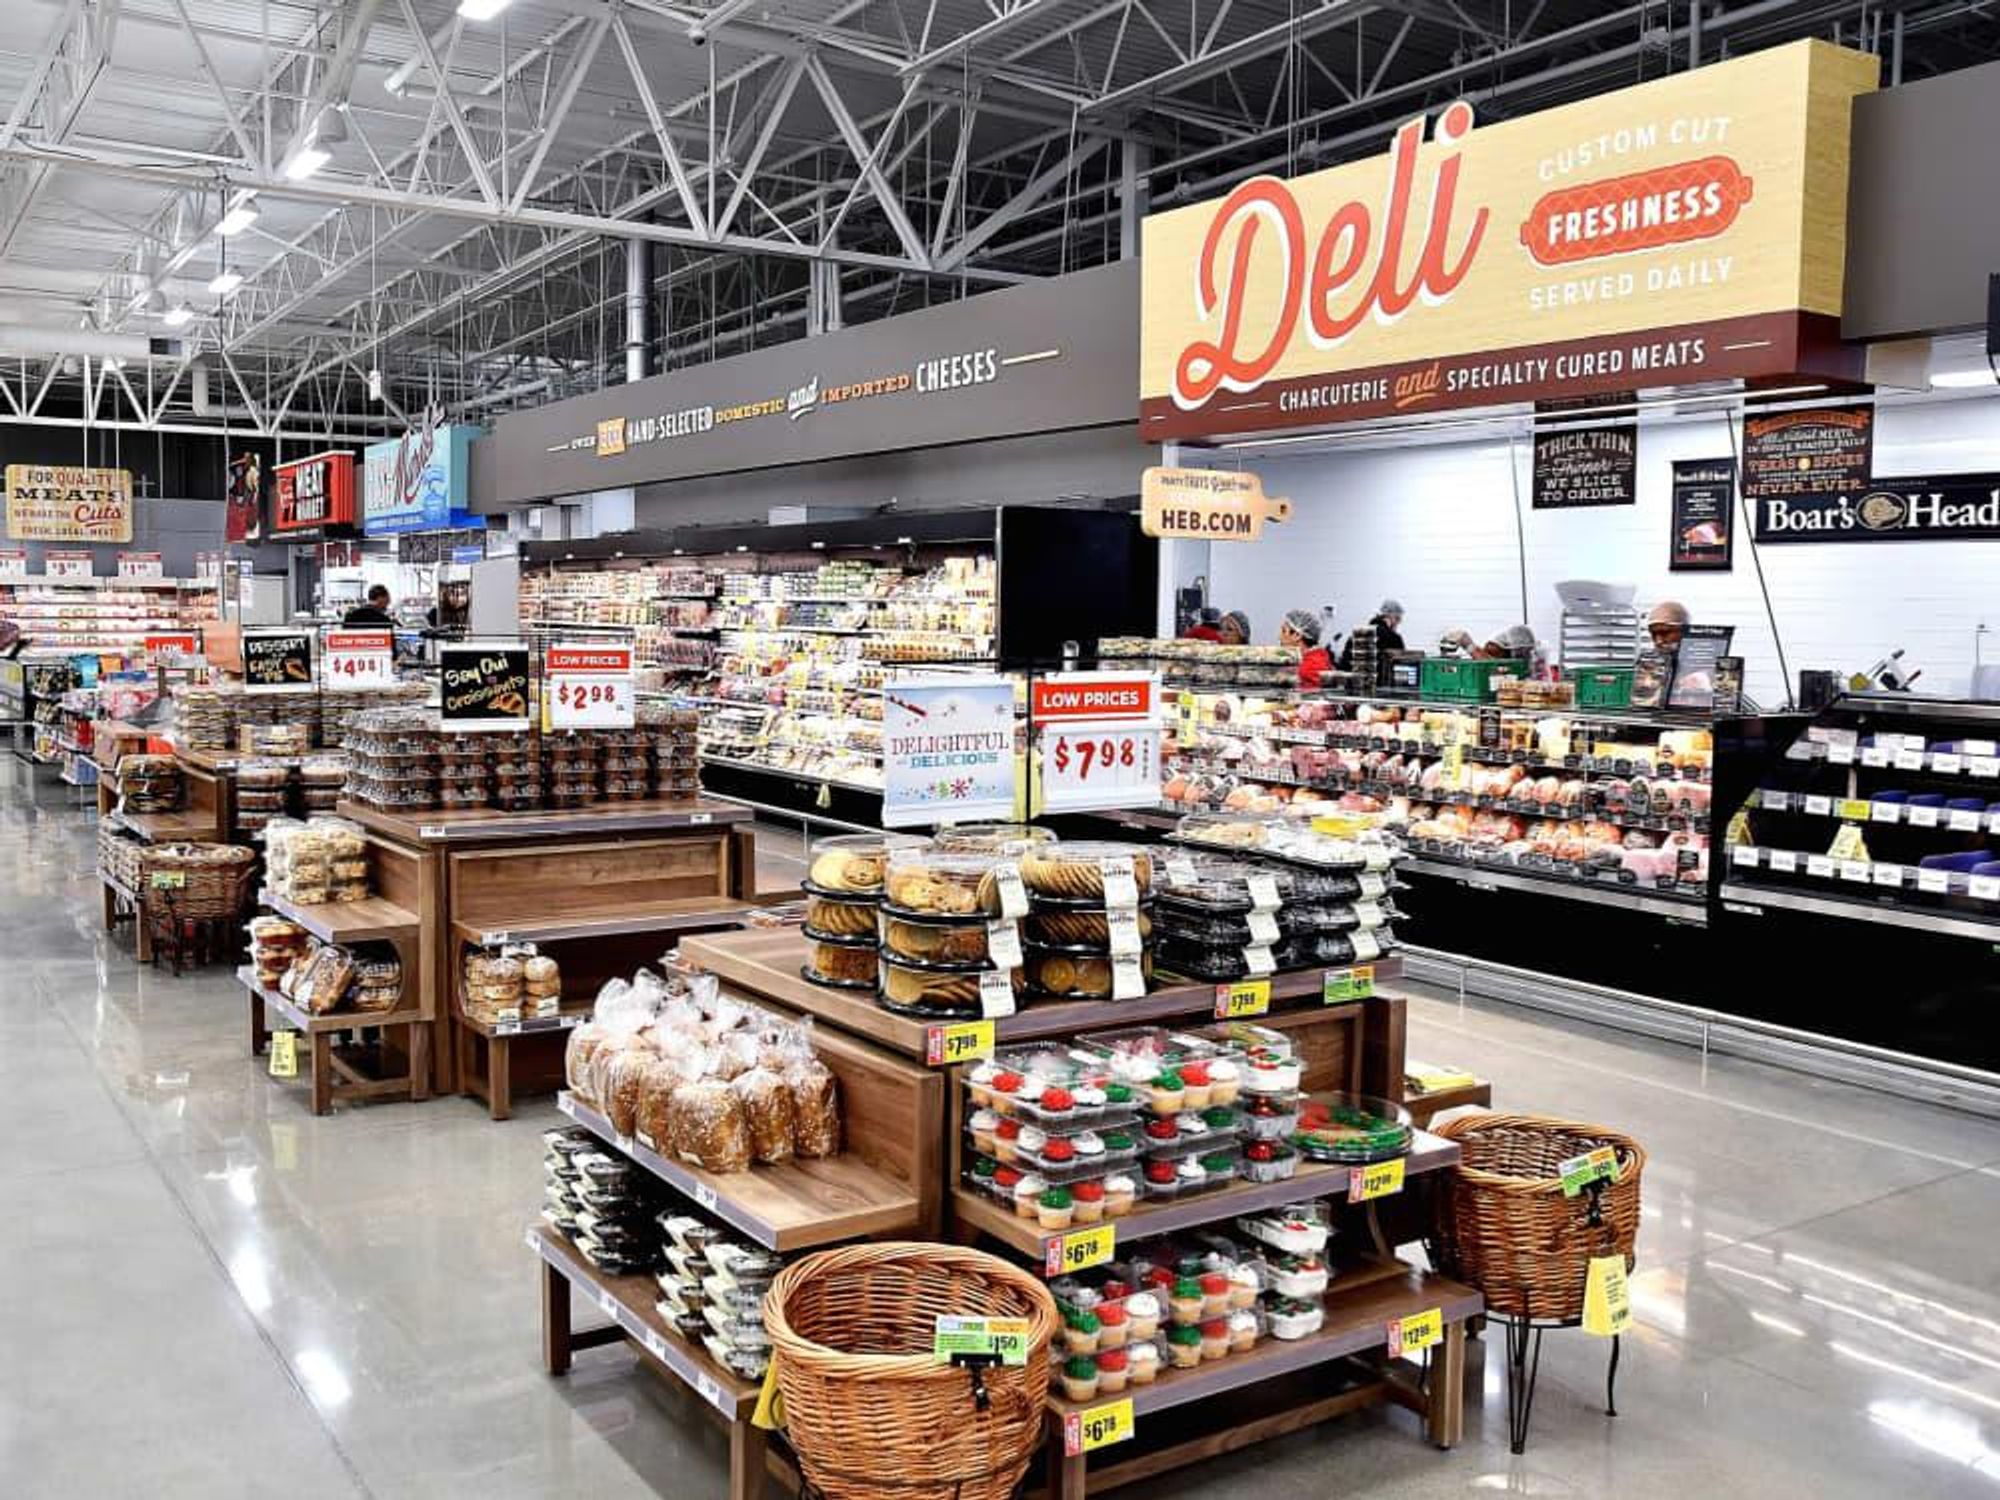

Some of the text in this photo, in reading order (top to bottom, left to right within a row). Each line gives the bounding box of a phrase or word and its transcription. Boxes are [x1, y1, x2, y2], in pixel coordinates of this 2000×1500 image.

[1539, 117, 1733, 182] CUSTOM CUT
[1548, 182, 1722, 245] FRESHNESS
[1172, 102, 1489, 408] Deli
[1529, 256, 1734, 309] SERVED DAILY
[1278, 339, 1706, 412] CHARCUTERIE and SPECIALTY CURED MEATS
[626, 406, 714, 445] HAND-SELECTED
[715, 399, 785, 423] DOMESTIC
[788, 376, 818, 413] and
[821, 374, 911, 404] IMPORTED
[916, 349, 996, 393] CHEESES
[28, 471, 113, 487] FOR QUALITY
[1545, 474, 1622, 489] WE SLICE
[14, 487, 126, 502] MEATS
[1540, 490, 1563, 501] TO
[74, 504, 122, 523] Cuts
[1161, 509, 1252, 533] HEB.COM
[1766, 489, 2000, 532] Boar's Head
[444, 655, 510, 687] Say Oui
[553, 655, 621, 666] LOW PRICES
[1042, 690, 1140, 709] LOW PRICES
[890, 731, 1010, 756] DELIGHTFUL
[909, 753, 999, 769] DELICIOUS
